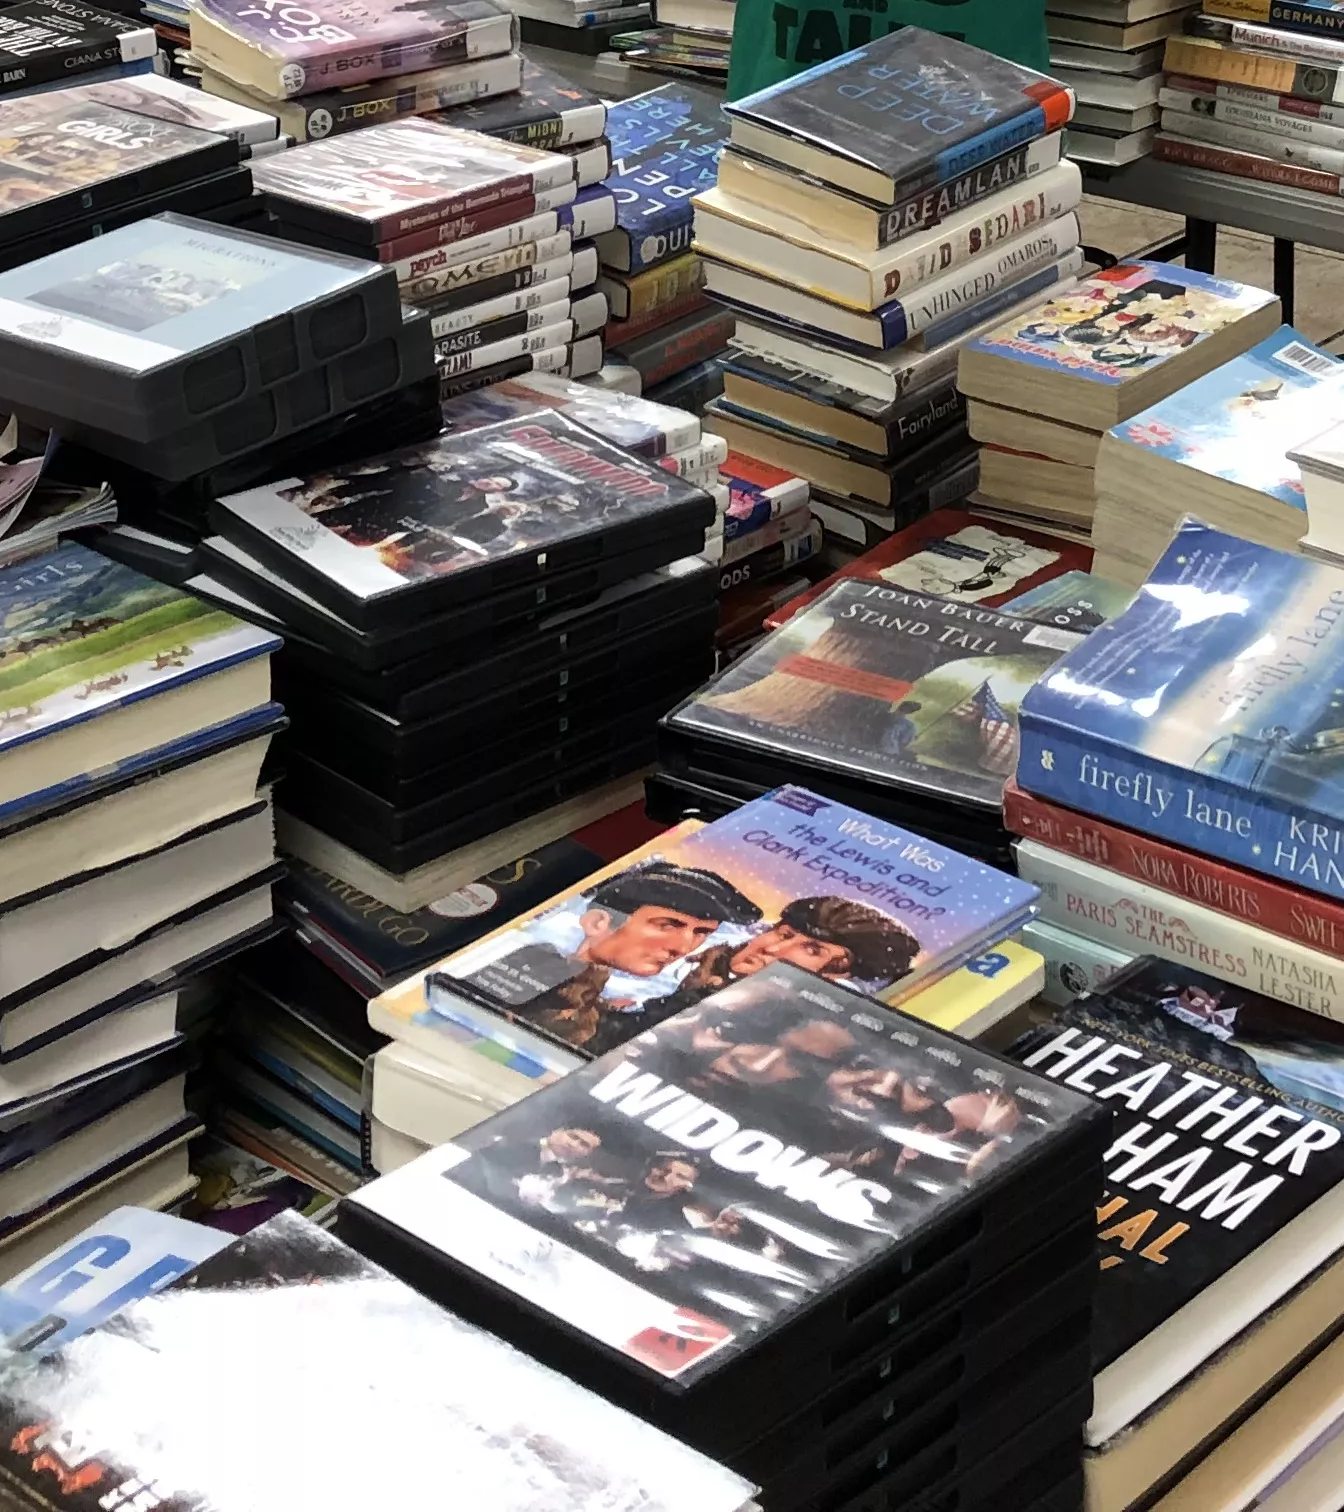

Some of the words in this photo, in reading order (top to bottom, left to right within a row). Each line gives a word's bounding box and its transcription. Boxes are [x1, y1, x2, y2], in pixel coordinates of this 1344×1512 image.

[64, 52, 102, 69] CIANA
[336, 53, 375, 69] BOX
[1234, 28, 1280, 48] Munich
[3, 67, 27, 85] BARN
[353, 97, 392, 118] BOX
[838, 84, 964, 135] DEEP
[1274, 117, 1314, 133] VOYAGES
[58, 119, 155, 151] GIRLS
[399, 210, 440, 232] Mysteries
[441, 207, 450, 219] of
[449, 201, 464, 216] the
[465, 191, 499, 209] Bermuda
[967, 191, 1046, 254] SEDARI
[409, 250, 447, 277] psych
[909, 271, 997, 332] UNHINGED
[434, 330, 481, 355] ARASITE
[899, 387, 961, 440] Fairyland
[840, 603, 932, 639] STAND
[937, 626, 999, 656] TALL
[864, 583, 933, 611] JOAN
[941, 601, 1027, 635] BAUER
[1078, 753, 1175, 818] firefly
[1185, 788, 1253, 839] lane
[787, 820, 831, 848] the
[826, 834, 896, 876] Lewis
[896, 872, 952, 899] and
[838, 817, 899, 854] What
[899, 841, 945, 875] Was
[741, 827, 805, 866] Clark
[803, 852, 947, 922] Expedition?
[1131, 845, 1179, 885] NORA
[1182, 861, 1262, 917] ROBERTS
[1066, 893, 1118, 929] PARIS
[1124, 908, 1247, 979] SEAMSTRESS
[1140, 903, 1168, 925] THE
[1252, 946, 1337, 993] NATASHA
[1259, 975, 1333, 1018] LESTER
[1158, 1045, 1197, 1067] TIMES
[1197, 1060, 1291, 1103] BESTSELLING
[1022, 1026, 1343, 1177] HEATHER
[586, 1059, 903, 1237] WIDOWS
[1102, 1121, 1285, 1231] HAM
